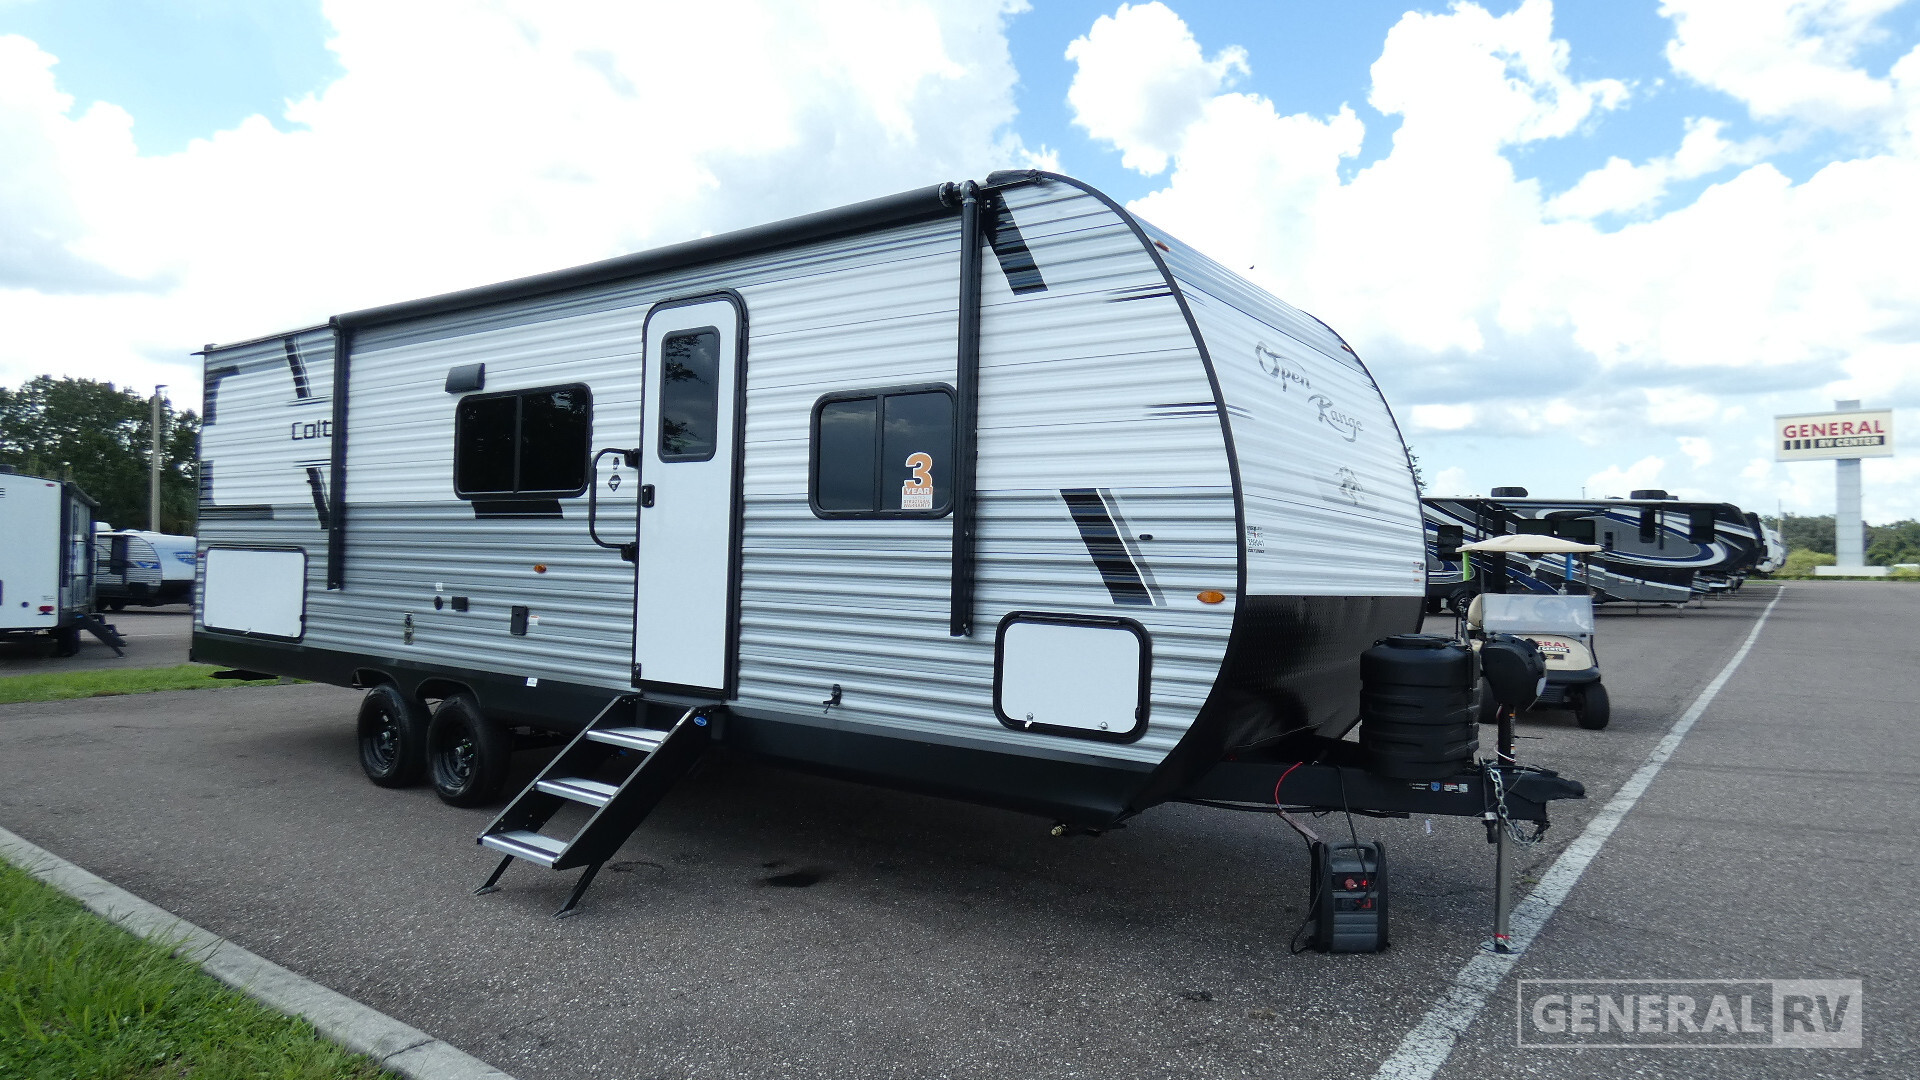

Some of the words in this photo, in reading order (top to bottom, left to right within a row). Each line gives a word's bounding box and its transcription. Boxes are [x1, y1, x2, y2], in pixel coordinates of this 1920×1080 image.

[1255, 341, 1311, 392] Open
[1308, 394, 1364, 442] Range
[292, 420, 332, 440] Colt
[1783, 420, 1885, 438] GENERAL
[1818, 438, 1834, 448] RV
[1835, 436, 1880, 447] CENTER
[905, 452, 933, 488] 3
[905, 487, 930, 495] YEAR
